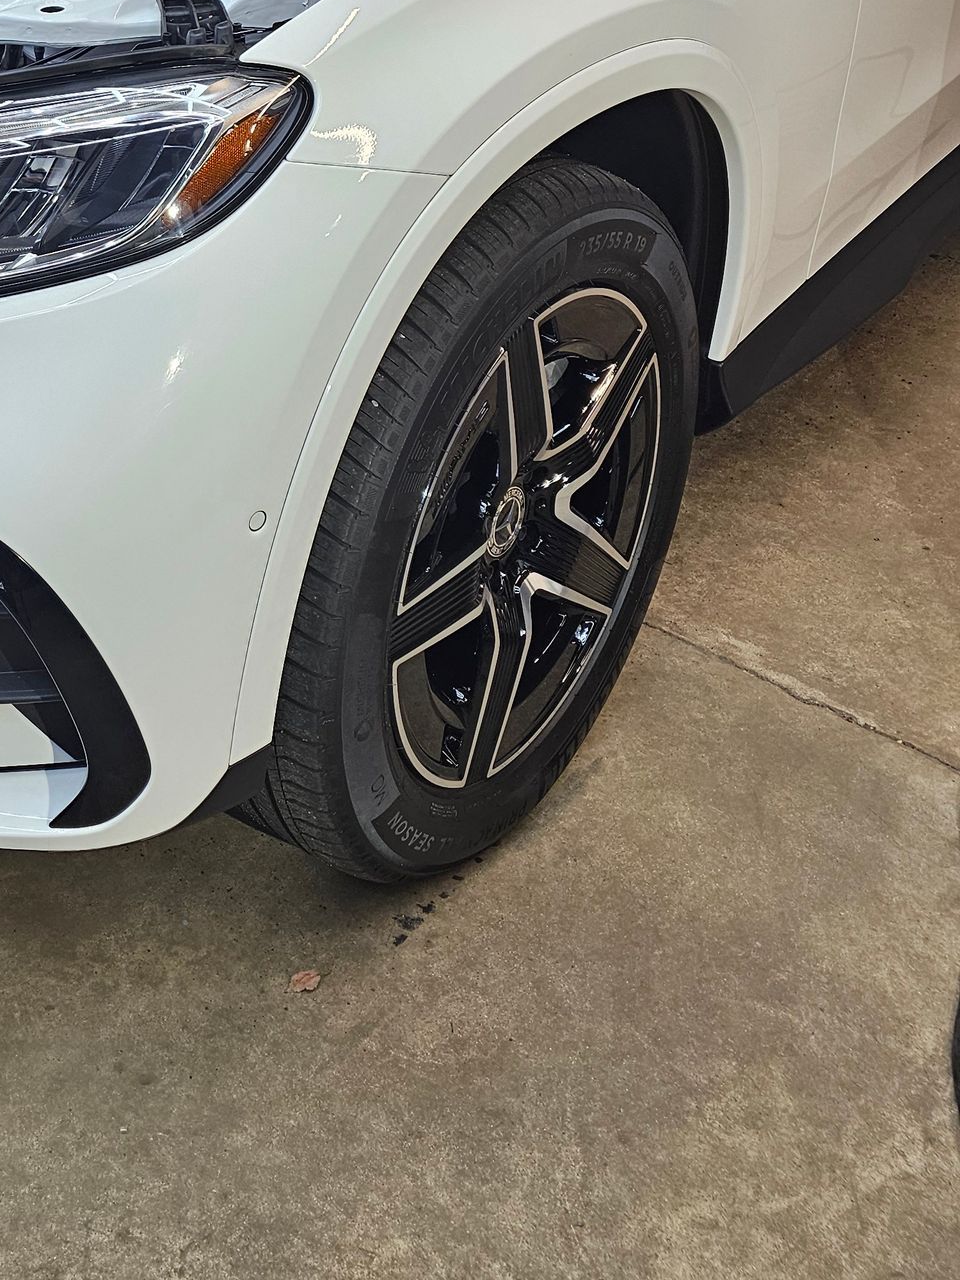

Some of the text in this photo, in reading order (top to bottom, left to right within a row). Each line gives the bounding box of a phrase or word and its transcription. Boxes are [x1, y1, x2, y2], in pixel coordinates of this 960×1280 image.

[580, 231, 647, 255] 235/55 R 19
[387, 811, 435, 852] SEASON
